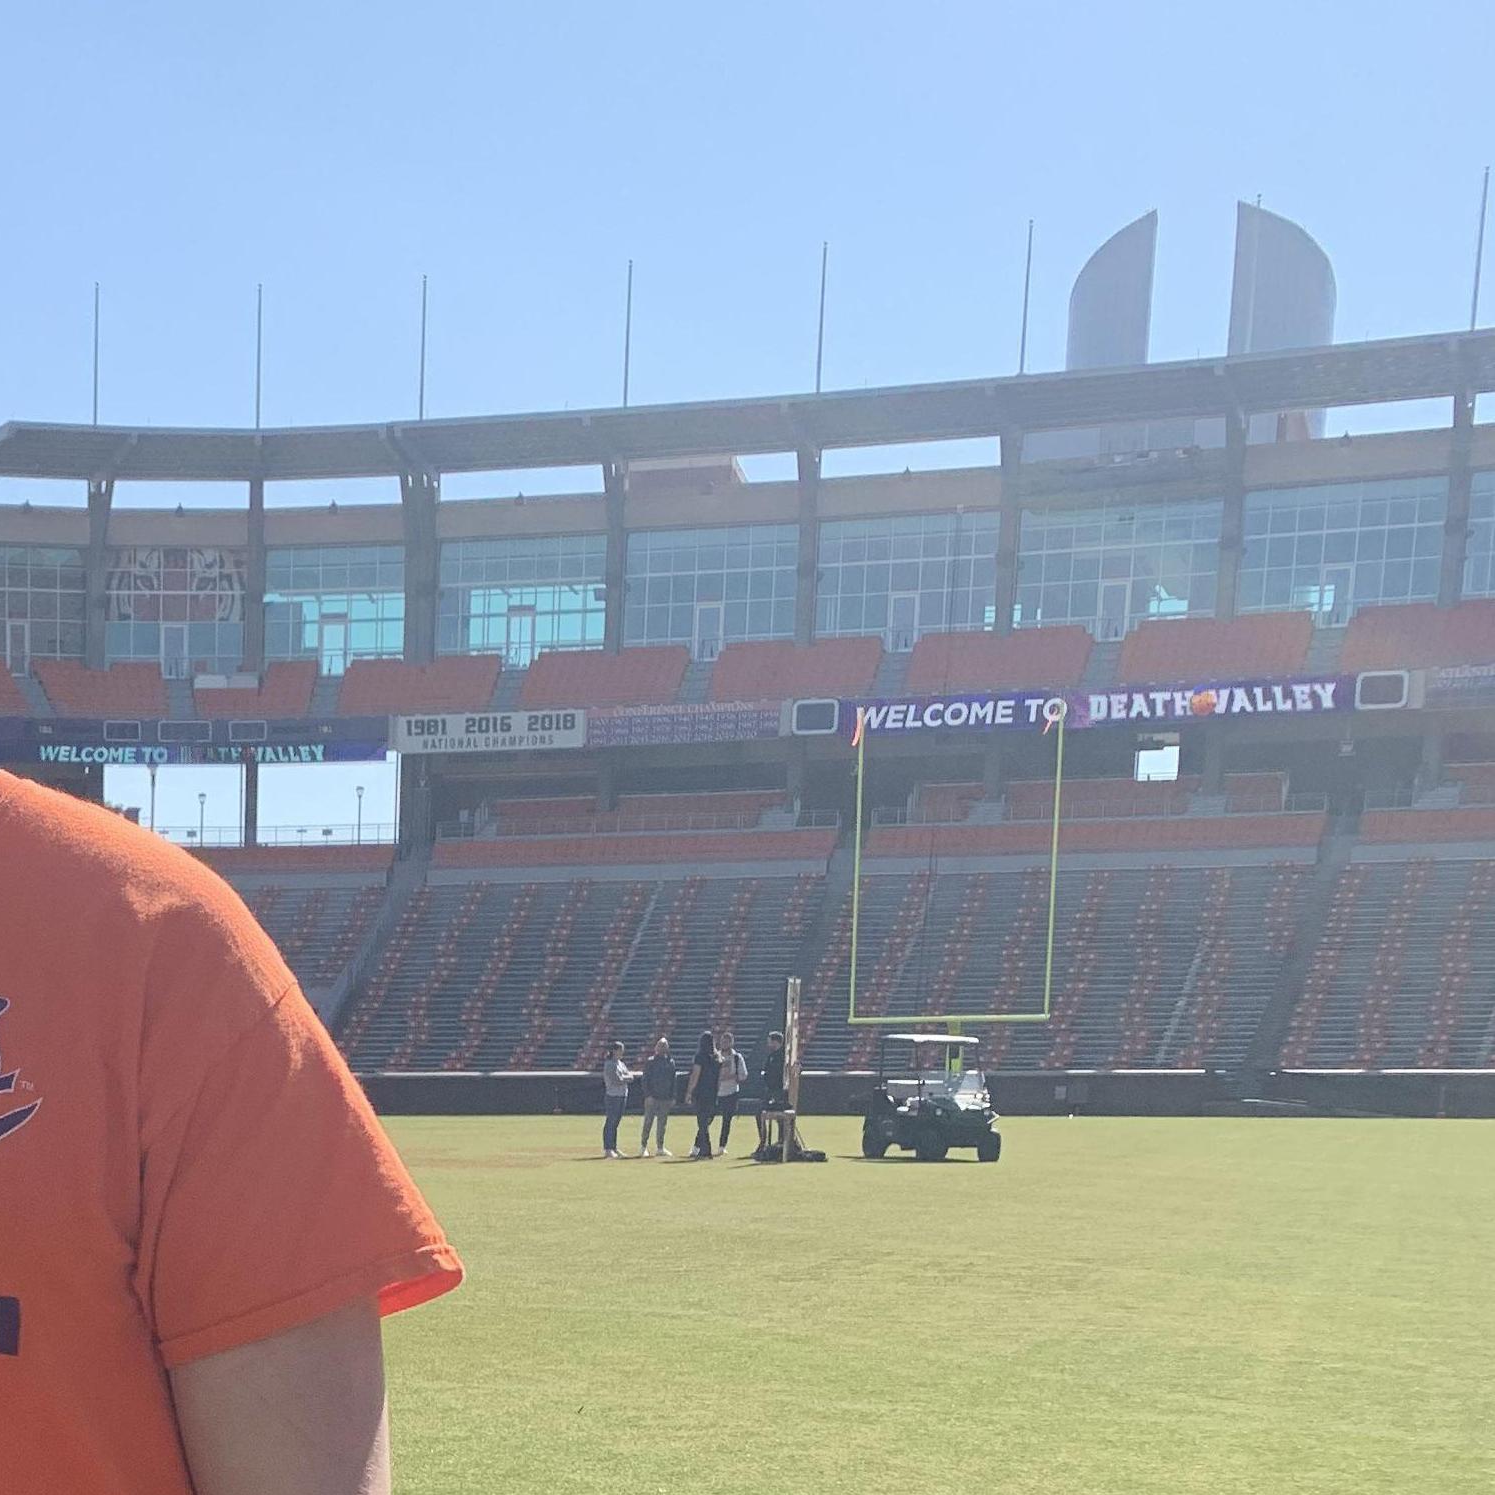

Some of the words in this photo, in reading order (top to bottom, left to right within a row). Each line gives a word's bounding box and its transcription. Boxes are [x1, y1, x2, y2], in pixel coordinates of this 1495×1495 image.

[856, 699, 1016, 730] WELCOME
[1024, 697, 1068, 723] TO
[1088, 691, 1194, 721] DEATH
[1209, 682, 1337, 715] VALLEY
[405, 718, 448, 737] 1981
[464, 715, 513, 735] 2016
[526, 712, 577, 732] 2018
[422, 737, 479, 750] NATIONAL
[484, 734, 554, 748] CHAMPIONS
[39, 745, 137, 763] WELCOME
[142, 746, 168, 763] TO
[253, 744, 325, 762] VALLEY
